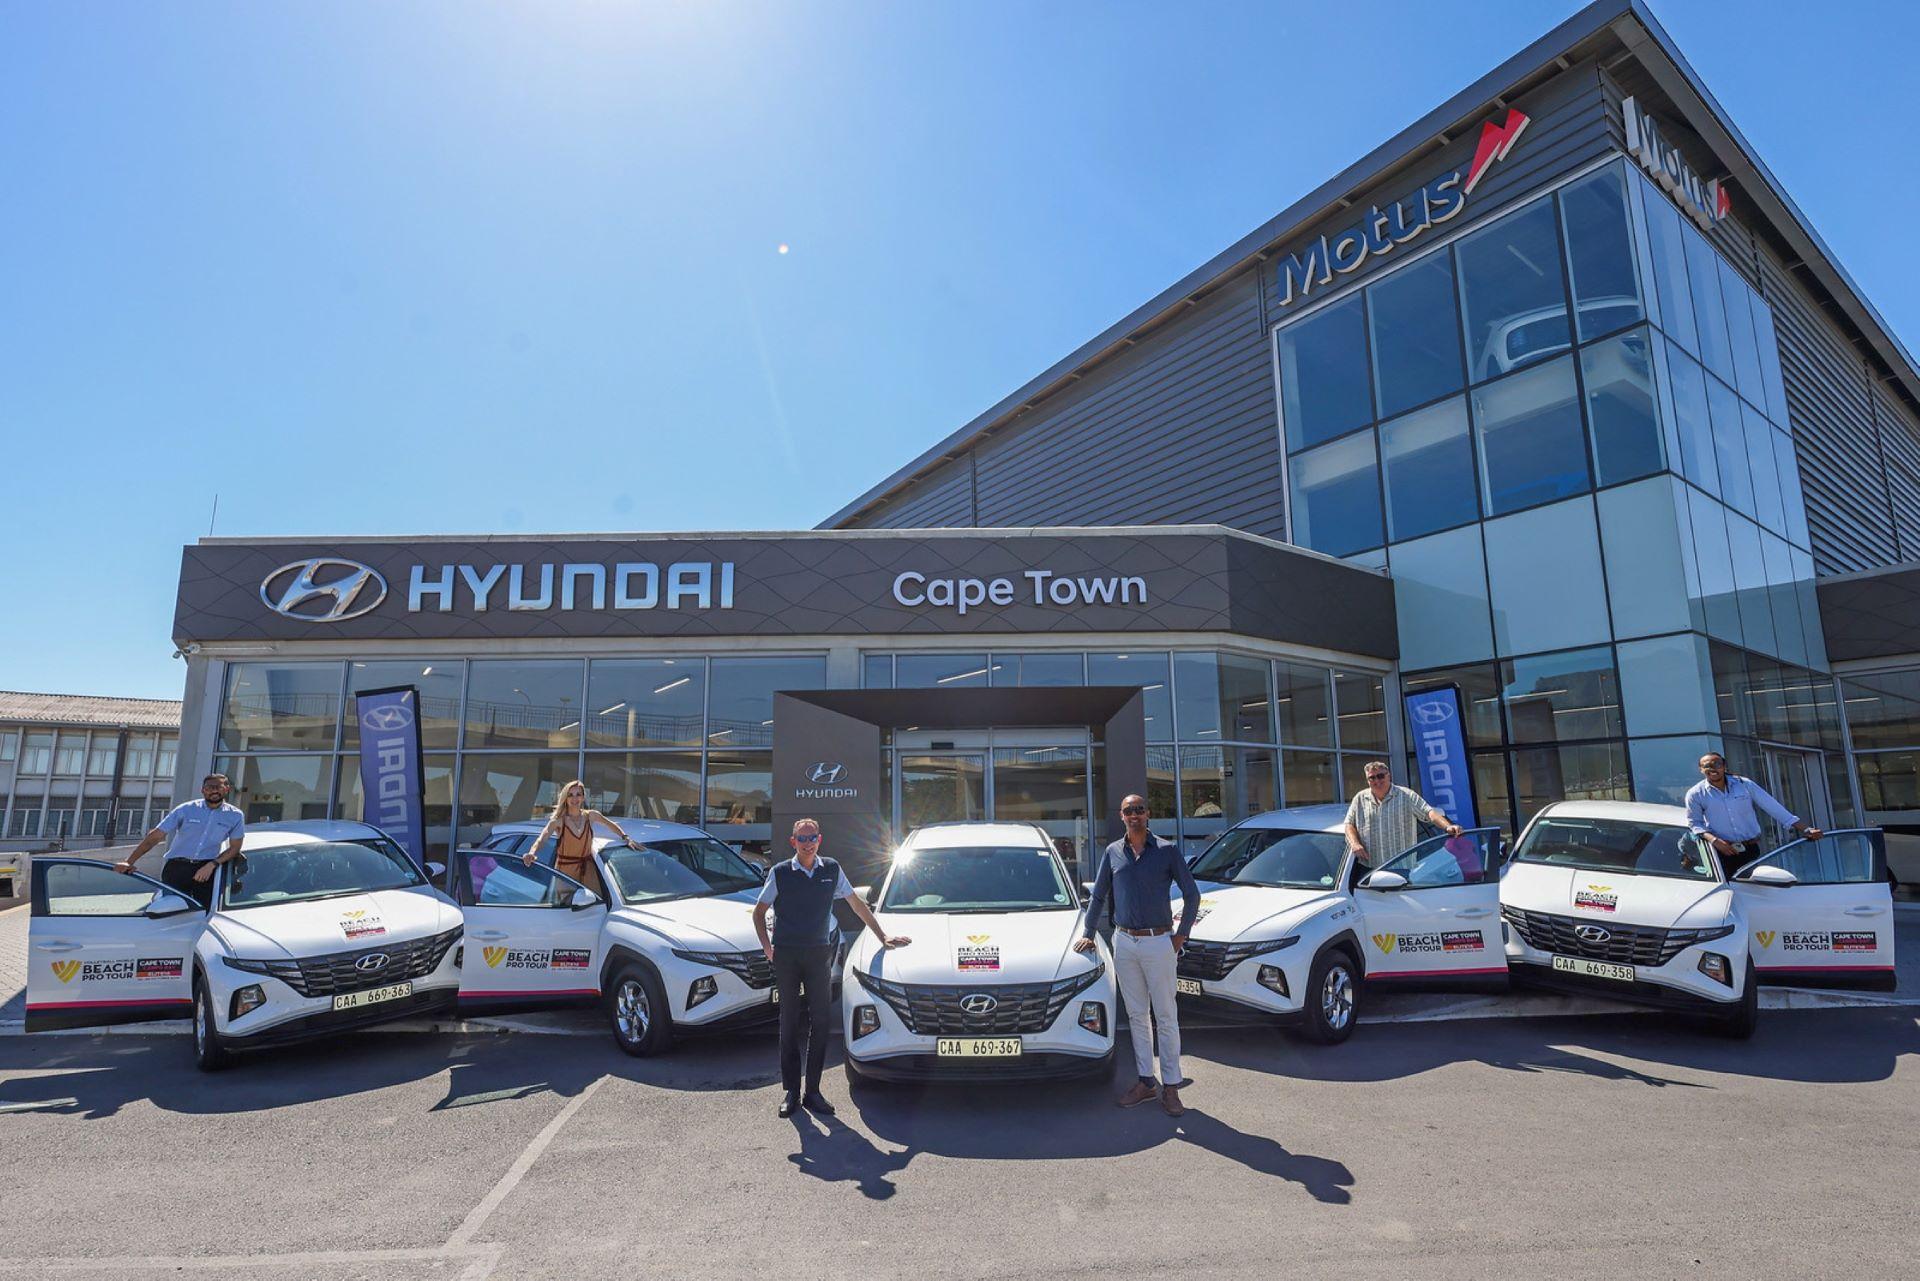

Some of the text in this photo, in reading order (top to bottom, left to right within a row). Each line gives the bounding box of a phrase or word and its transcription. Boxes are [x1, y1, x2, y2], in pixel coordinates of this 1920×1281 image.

[1276, 171, 1465, 307] Motus
[408, 562, 734, 611] HYUNDAI
[893, 569, 1148, 615] Cape Town
[795, 788, 858, 798] HYUNDAI
[1398, 935, 1440, 946] BEACH
[1783, 935, 1829, 944] BEACH
[1400, 945, 1418, 953] PRO
[1419, 944, 1441, 952] TOUR
[507, 952, 550, 962] BEACH
[83, 962, 134, 974] BEACH
[506, 961, 524, 969] PRO
[525, 961, 548, 969] TOUR
[1555, 958, 1633, 980] CAA 669-358
[82, 973, 105, 982] PRO
[106, 972, 134, 980] TOUR
[336, 984, 411, 1009] CAA 669-363
[940, 1041, 1019, 1054] CAA 669-367
